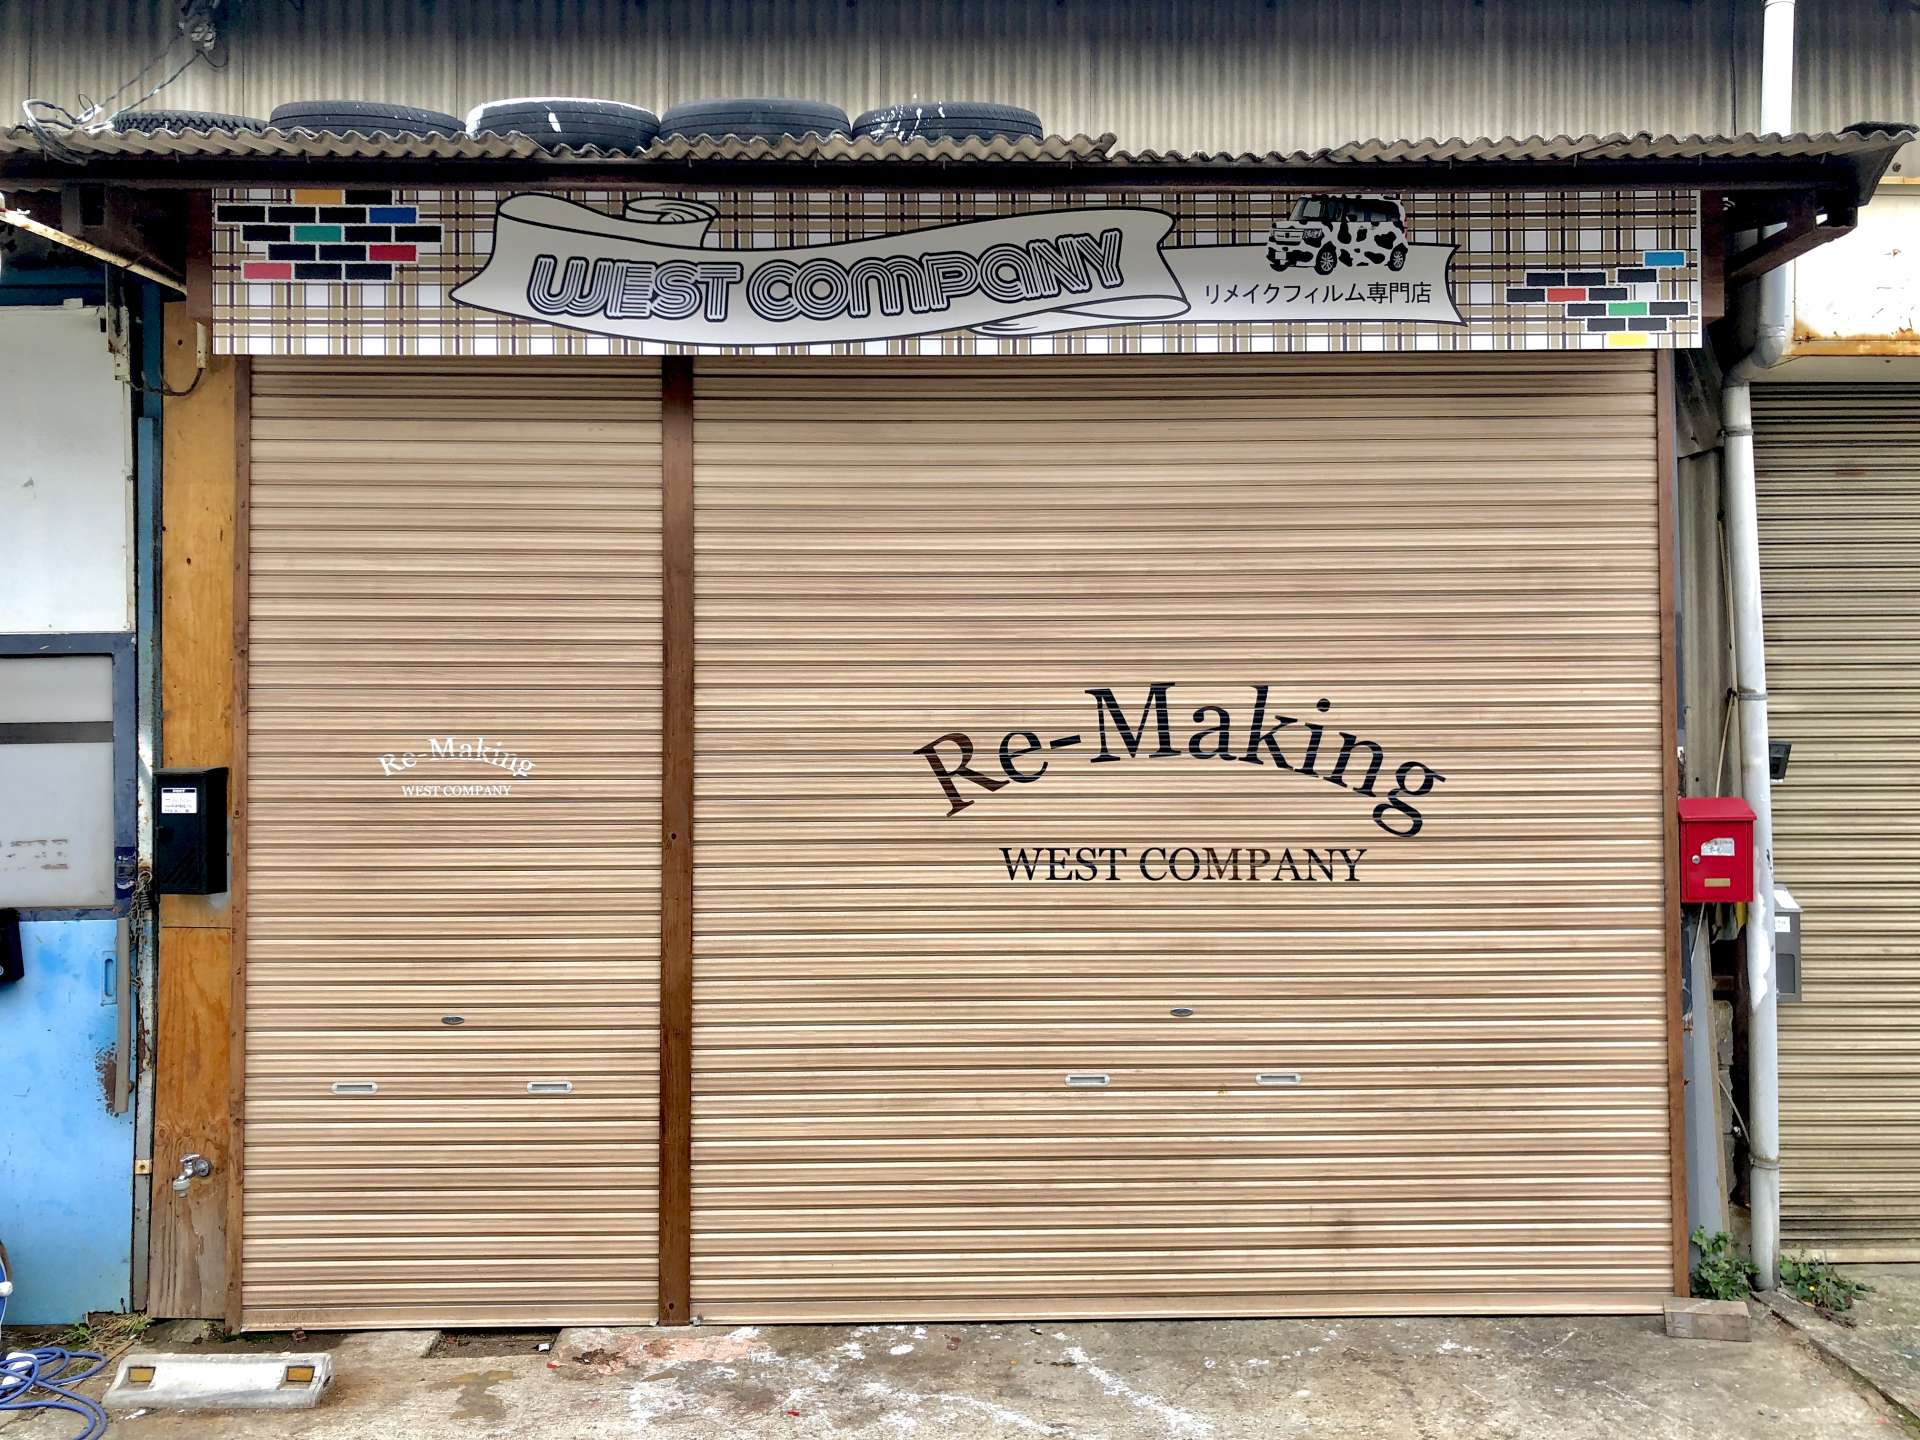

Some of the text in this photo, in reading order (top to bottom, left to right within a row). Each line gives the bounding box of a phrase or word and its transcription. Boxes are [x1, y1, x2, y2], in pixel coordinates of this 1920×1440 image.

[527, 228, 1123, 322] WEST COMPANY
[1205, 281, 1432, 305] リメイクフィルム専門店
[377, 736, 536, 777] Re-Making
[913, 682, 1446, 838] Re-Making
[400, 785, 512, 797] WEST COMPANY
[998, 847, 1368, 882] WEST COMPANY
